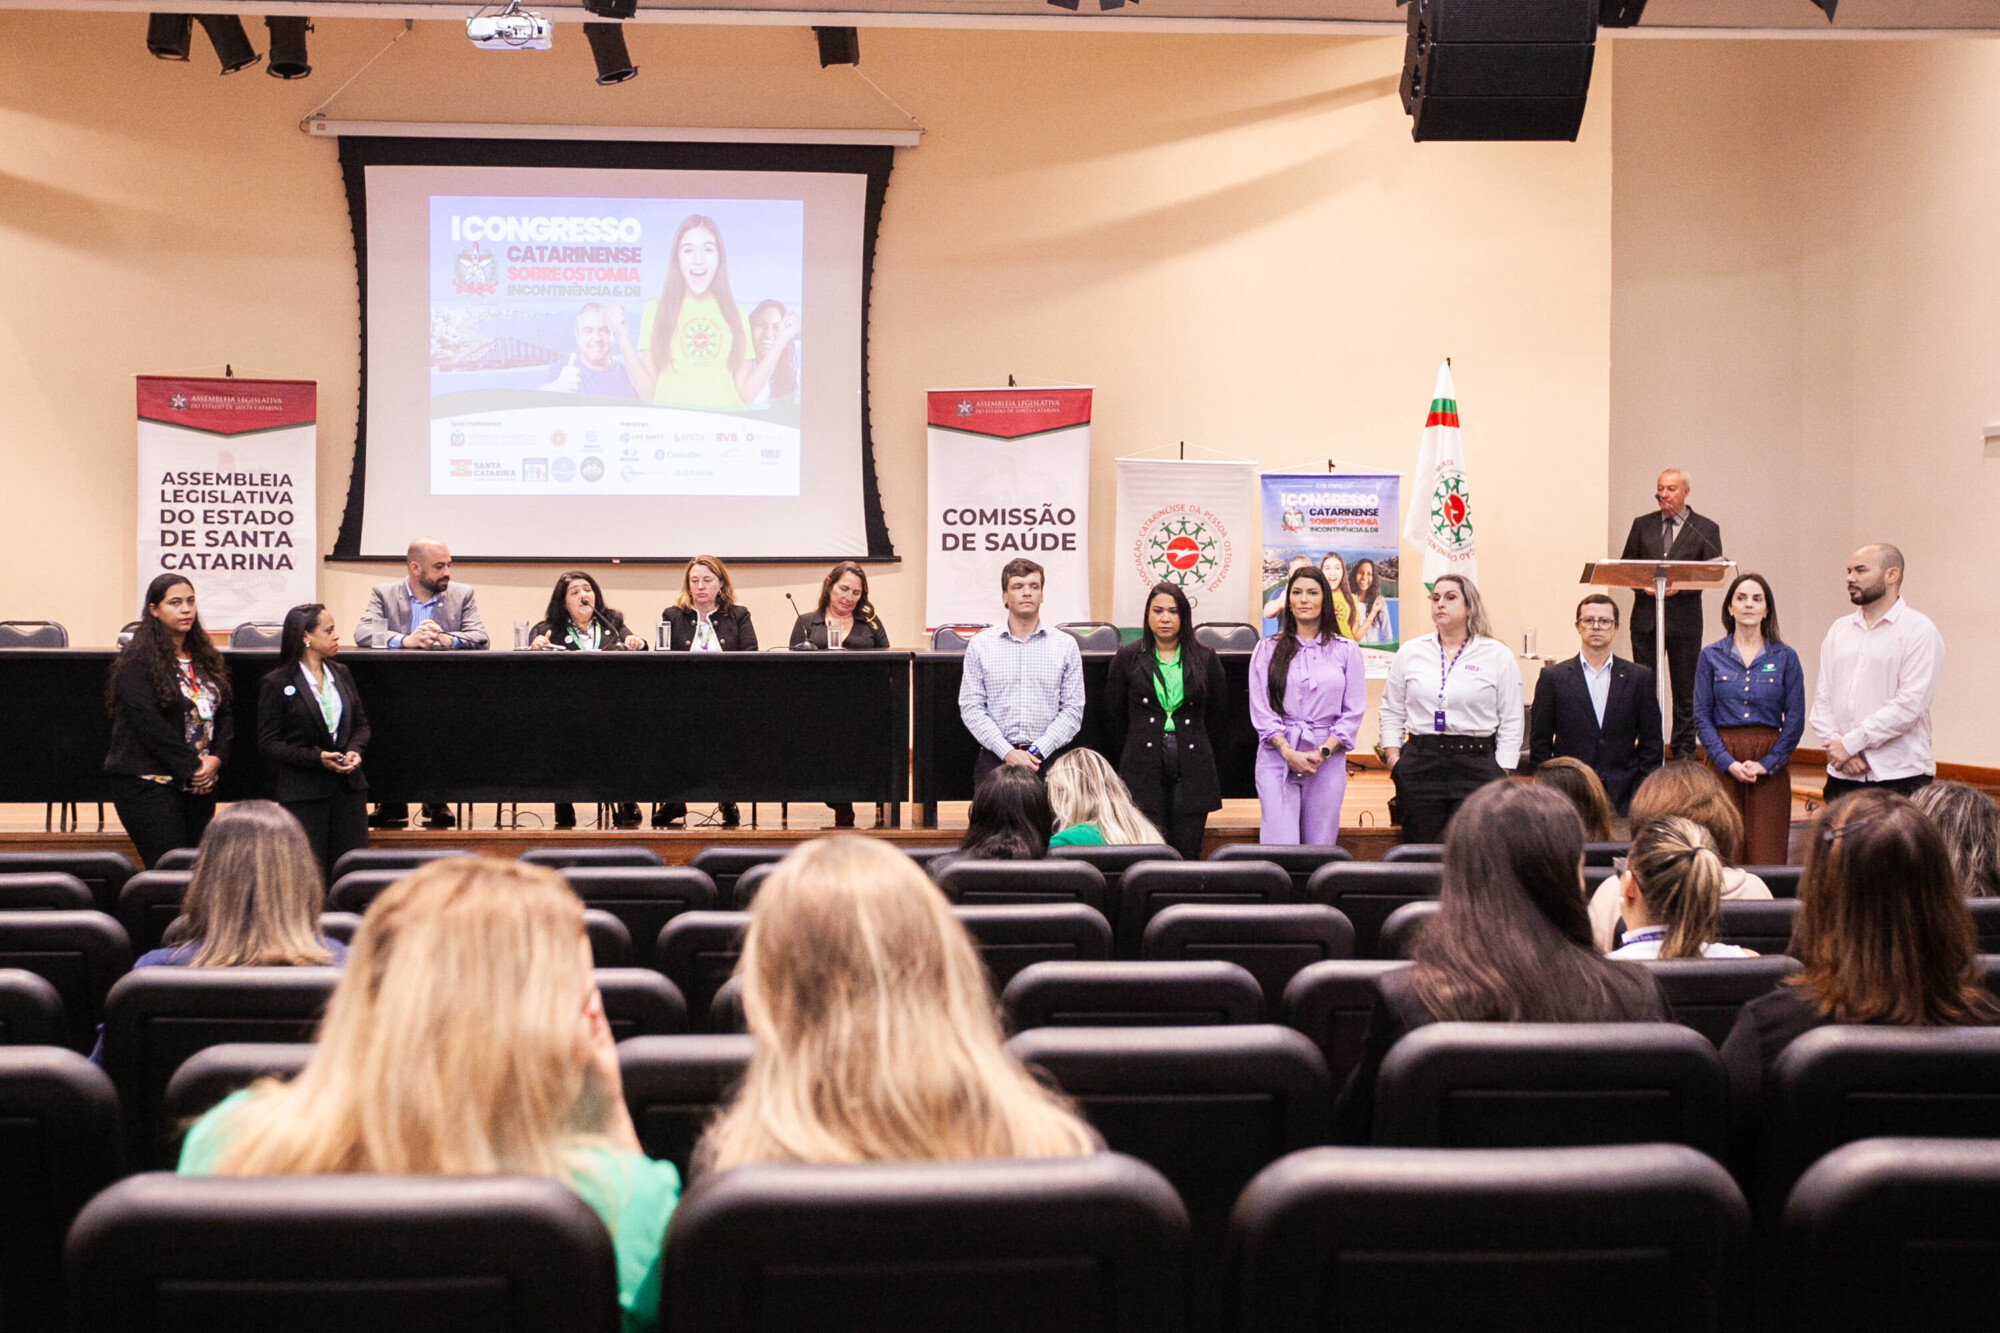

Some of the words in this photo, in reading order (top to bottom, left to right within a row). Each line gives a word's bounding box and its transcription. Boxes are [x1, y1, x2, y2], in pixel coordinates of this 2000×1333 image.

[462, 216, 642, 243] CONGRESSO
[506, 246, 642, 264] CATARINENSE
[507, 266, 561, 282] SOBRE
[562, 267, 640, 282] OSTOMIA
[508, 281, 611, 297] INCONTINÊNCIA
[612, 285, 622, 297] &
[191, 395, 236, 403] ASSEMBLEIA
[237, 396, 283, 404] LEGISLATIVA
[161, 471, 294, 487] ASSEMBLEIA
[160, 489, 294, 505] LEGISLATIVA
[1287, 493, 1379, 507] CONGRESSO
[160, 509, 195, 524] DO
[202, 509, 294, 526] ESTADO
[942, 503, 1076, 526] COMISSÃO
[1189, 504, 1201, 514] DA
[1309, 508, 1379, 517] CATARINENSE
[1139, 504, 1186, 537] CATARINENSE
[1204, 510, 1228, 538] PESSOA
[1309, 517, 1337, 525] SOBRE
[1338, 518, 1378, 526] OSTOMIA
[160, 529, 196, 547] DE
[204, 530, 294, 548] SANTA
[941, 532, 976, 551] DE
[985, 527, 1077, 552] SAÚDE
[160, 552, 294, 571] CATARINA
[1207, 540, 1232, 593] OSTOMIZADA
